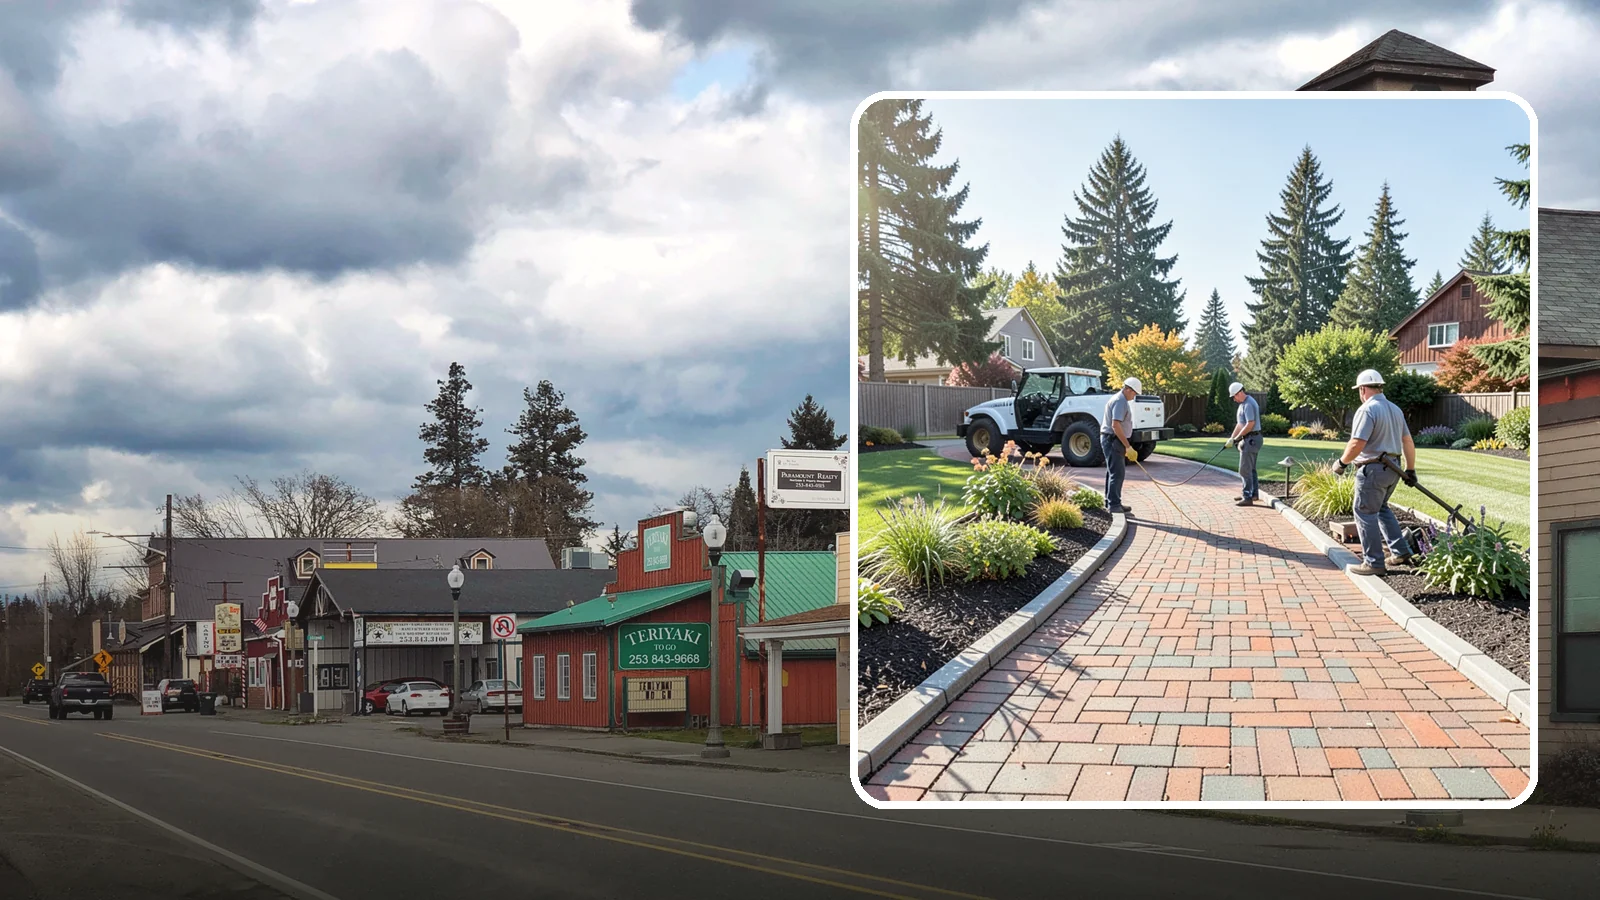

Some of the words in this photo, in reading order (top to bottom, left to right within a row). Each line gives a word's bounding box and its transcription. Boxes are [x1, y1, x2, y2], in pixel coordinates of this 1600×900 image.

[781, 471, 815, 479] PARAMOUNT
[817, 472, 839, 480] REALTY
[625, 627, 702, 646] TERIYAKI
[653, 643, 665, 651] TO
[665, 643, 677, 651] GO
[628, 654, 649, 664] 253
[651, 653, 700, 664] 843-9668
[639, 681, 673, 691] TERIYAKI
